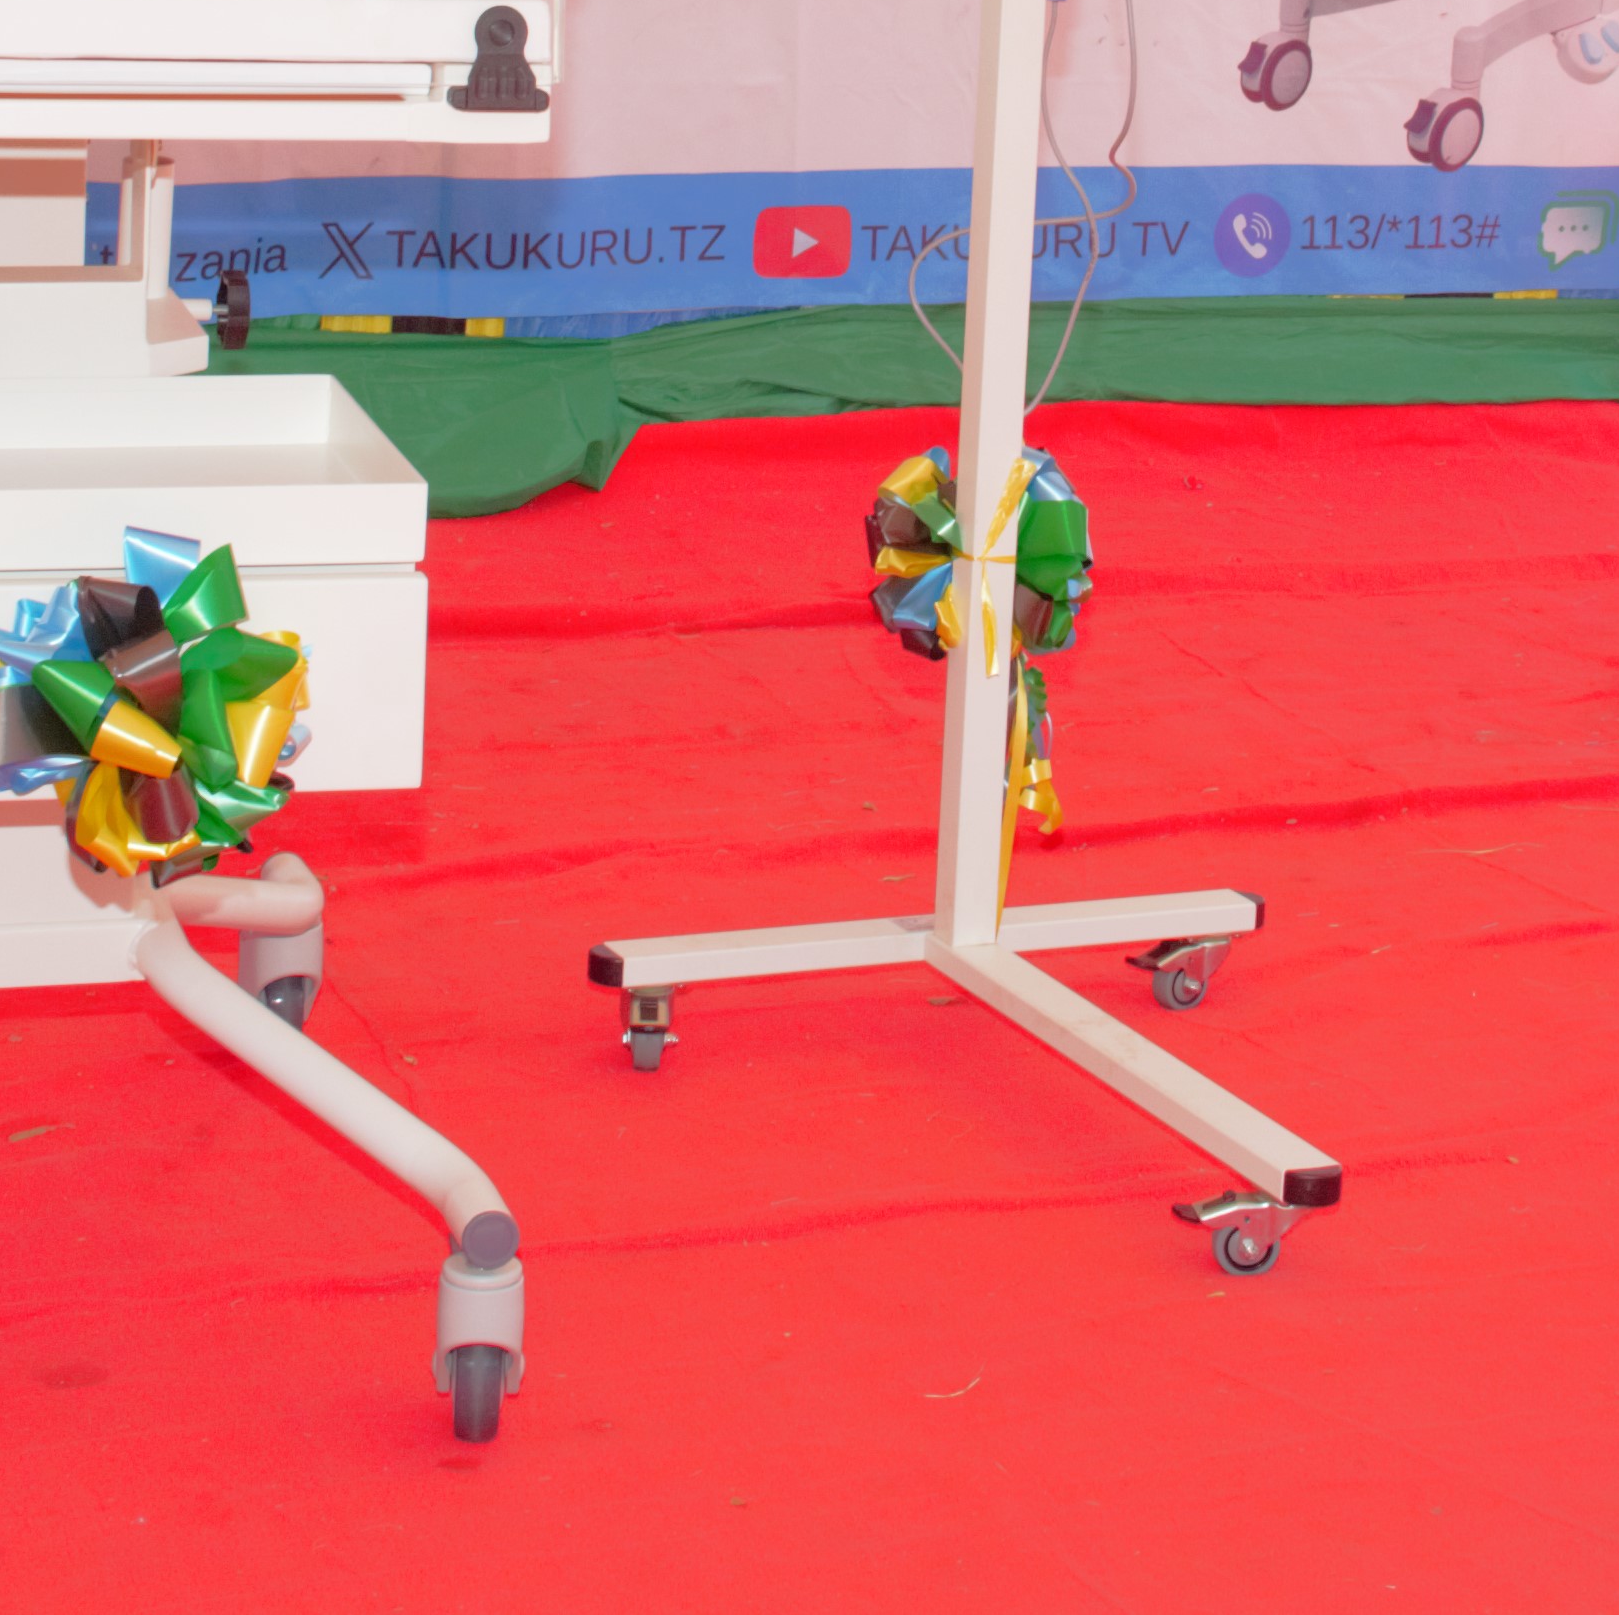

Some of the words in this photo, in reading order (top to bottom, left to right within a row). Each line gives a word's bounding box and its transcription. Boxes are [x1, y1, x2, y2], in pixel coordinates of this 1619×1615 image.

[386, 223, 727, 271] TAKUKURU.TZ
[861, 221, 1116, 262] TAKUURU
[1132, 220, 1190, 259] TV
